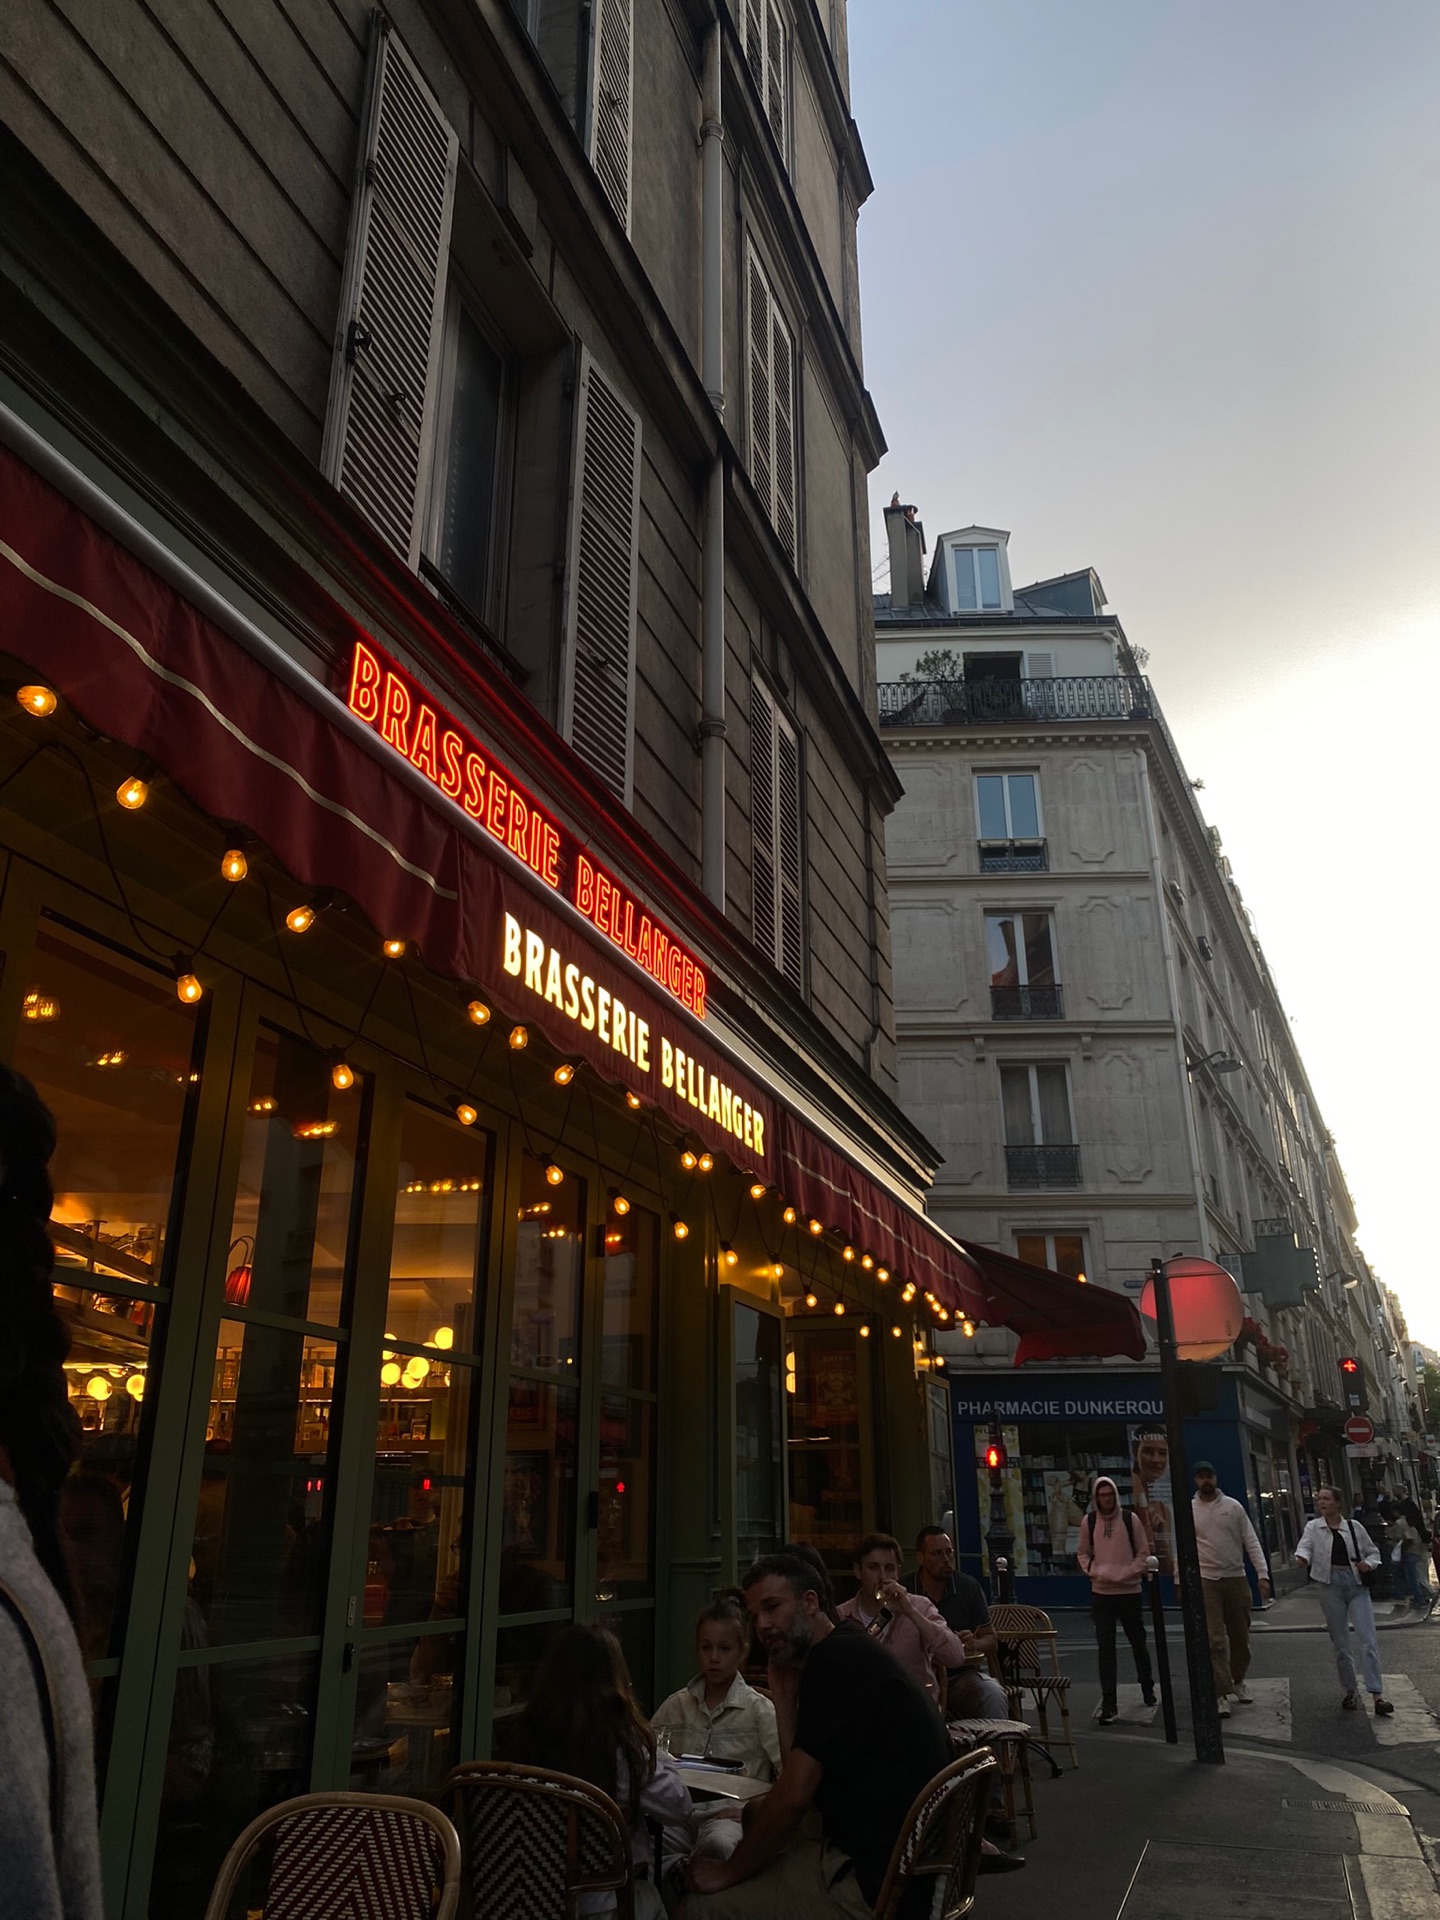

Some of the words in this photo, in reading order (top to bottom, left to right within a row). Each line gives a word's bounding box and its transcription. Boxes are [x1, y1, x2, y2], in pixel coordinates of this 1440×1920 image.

[350, 642, 561, 888] BRASSERIE
[576, 855, 706, 1020] BELLANGER
[503, 911, 651, 1073] BRASSERIE
[661, 1036, 765, 1156] BELLANGER
[957, 1401, 1060, 1415] PHARMACIE
[1064, 1400, 1164, 1415] DUNKERQU
